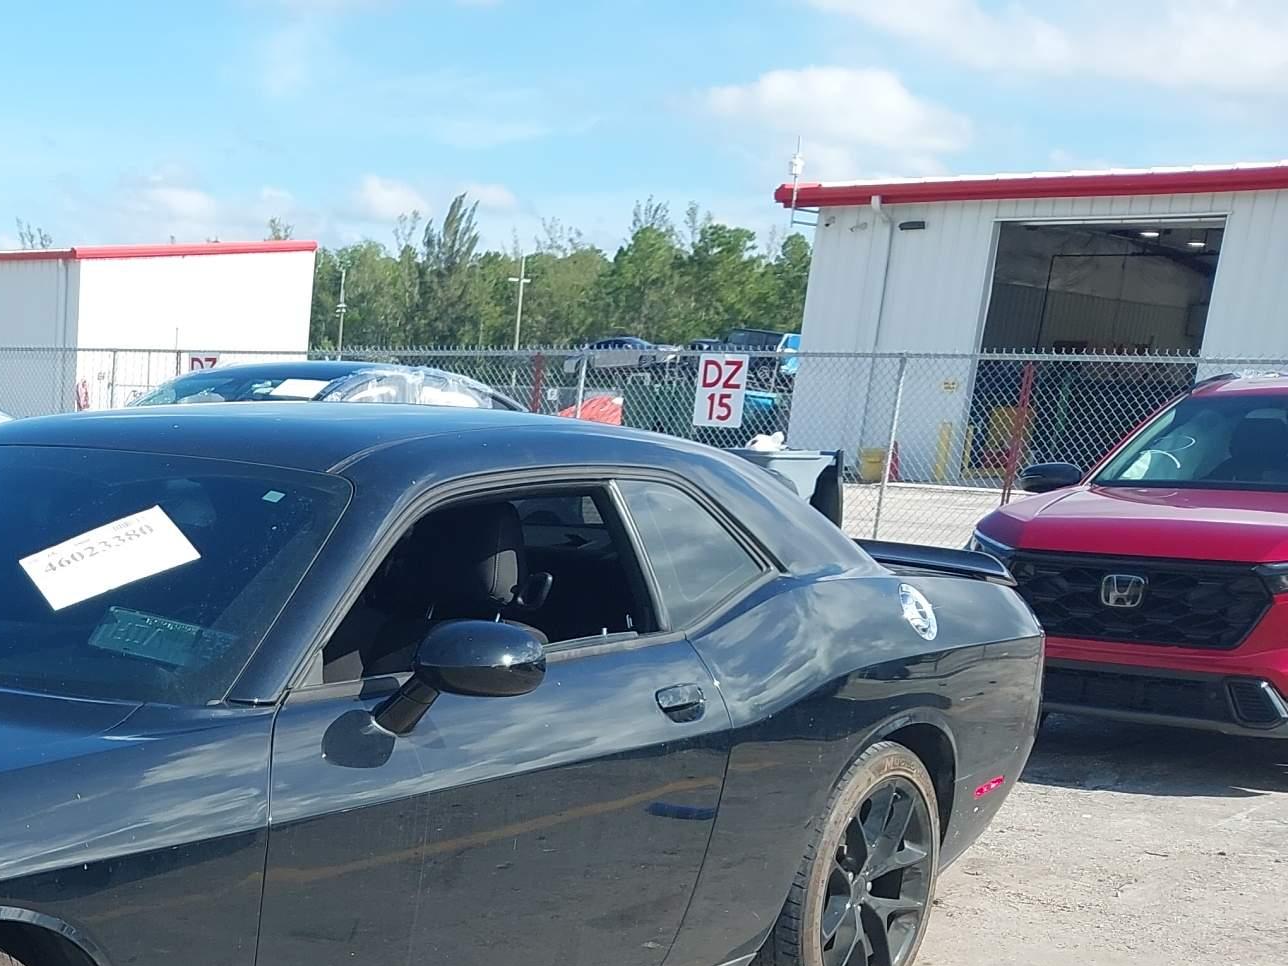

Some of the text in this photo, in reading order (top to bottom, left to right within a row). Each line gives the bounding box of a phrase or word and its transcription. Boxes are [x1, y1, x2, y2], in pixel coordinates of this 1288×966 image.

[702, 359, 744, 389] DZ
[707, 392, 732, 421] 15
[44, 523, 155, 574] 46023380
